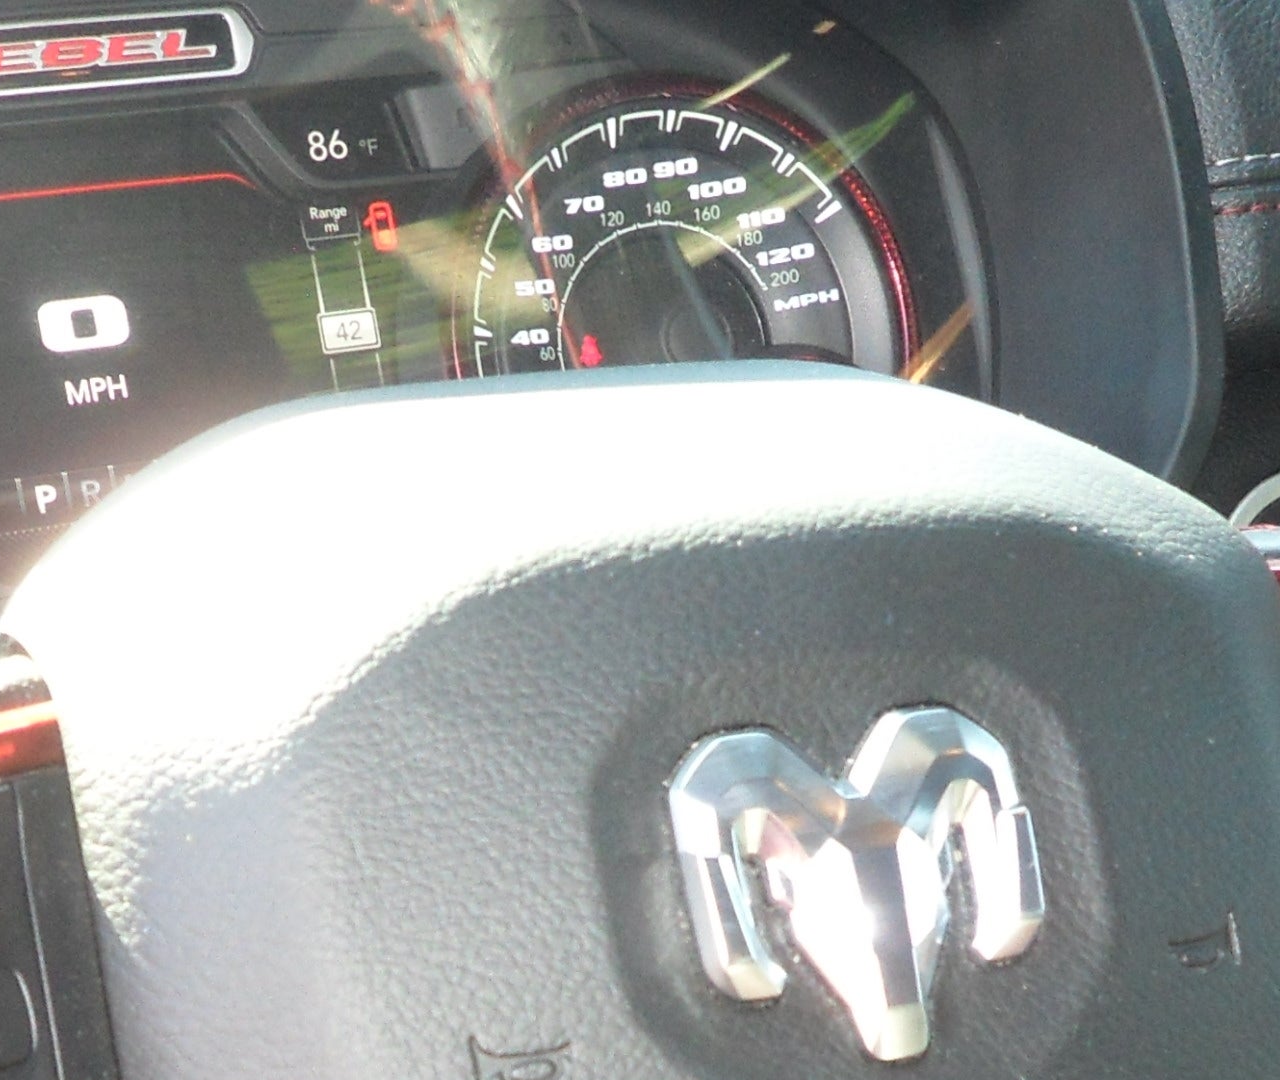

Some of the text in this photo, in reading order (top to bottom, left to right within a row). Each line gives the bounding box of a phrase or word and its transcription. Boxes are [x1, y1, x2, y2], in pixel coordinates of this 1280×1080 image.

[307, 129, 349, 162] 86
[603, 169, 647, 187] 80
[653, 157, 699, 181] 90
[686, 176, 748, 201] 100
[308, 203, 349, 225] Range
[563, 194, 606, 216] 70
[645, 202, 672, 218] 140
[693, 206, 721, 224] 160
[324, 219, 340, 234] mi
[599, 209, 625, 228] 120
[735, 206, 787, 230] 110
[531, 233, 574, 253] 60
[736, 230, 764, 248] 180
[551, 252, 576, 270] 100
[754, 242, 816, 268] 120
[513, 278, 556, 297] 50
[770, 267, 801, 288] 200
[773, 287, 840, 313] MPH
[36, 293, 131, 353] 0
[335, 320, 364, 343] 42
[510, 327, 550, 346] 40
[539, 348, 557, 362] 60
[64, 373, 129, 406] MPH
[34, 484, 58, 515] P
